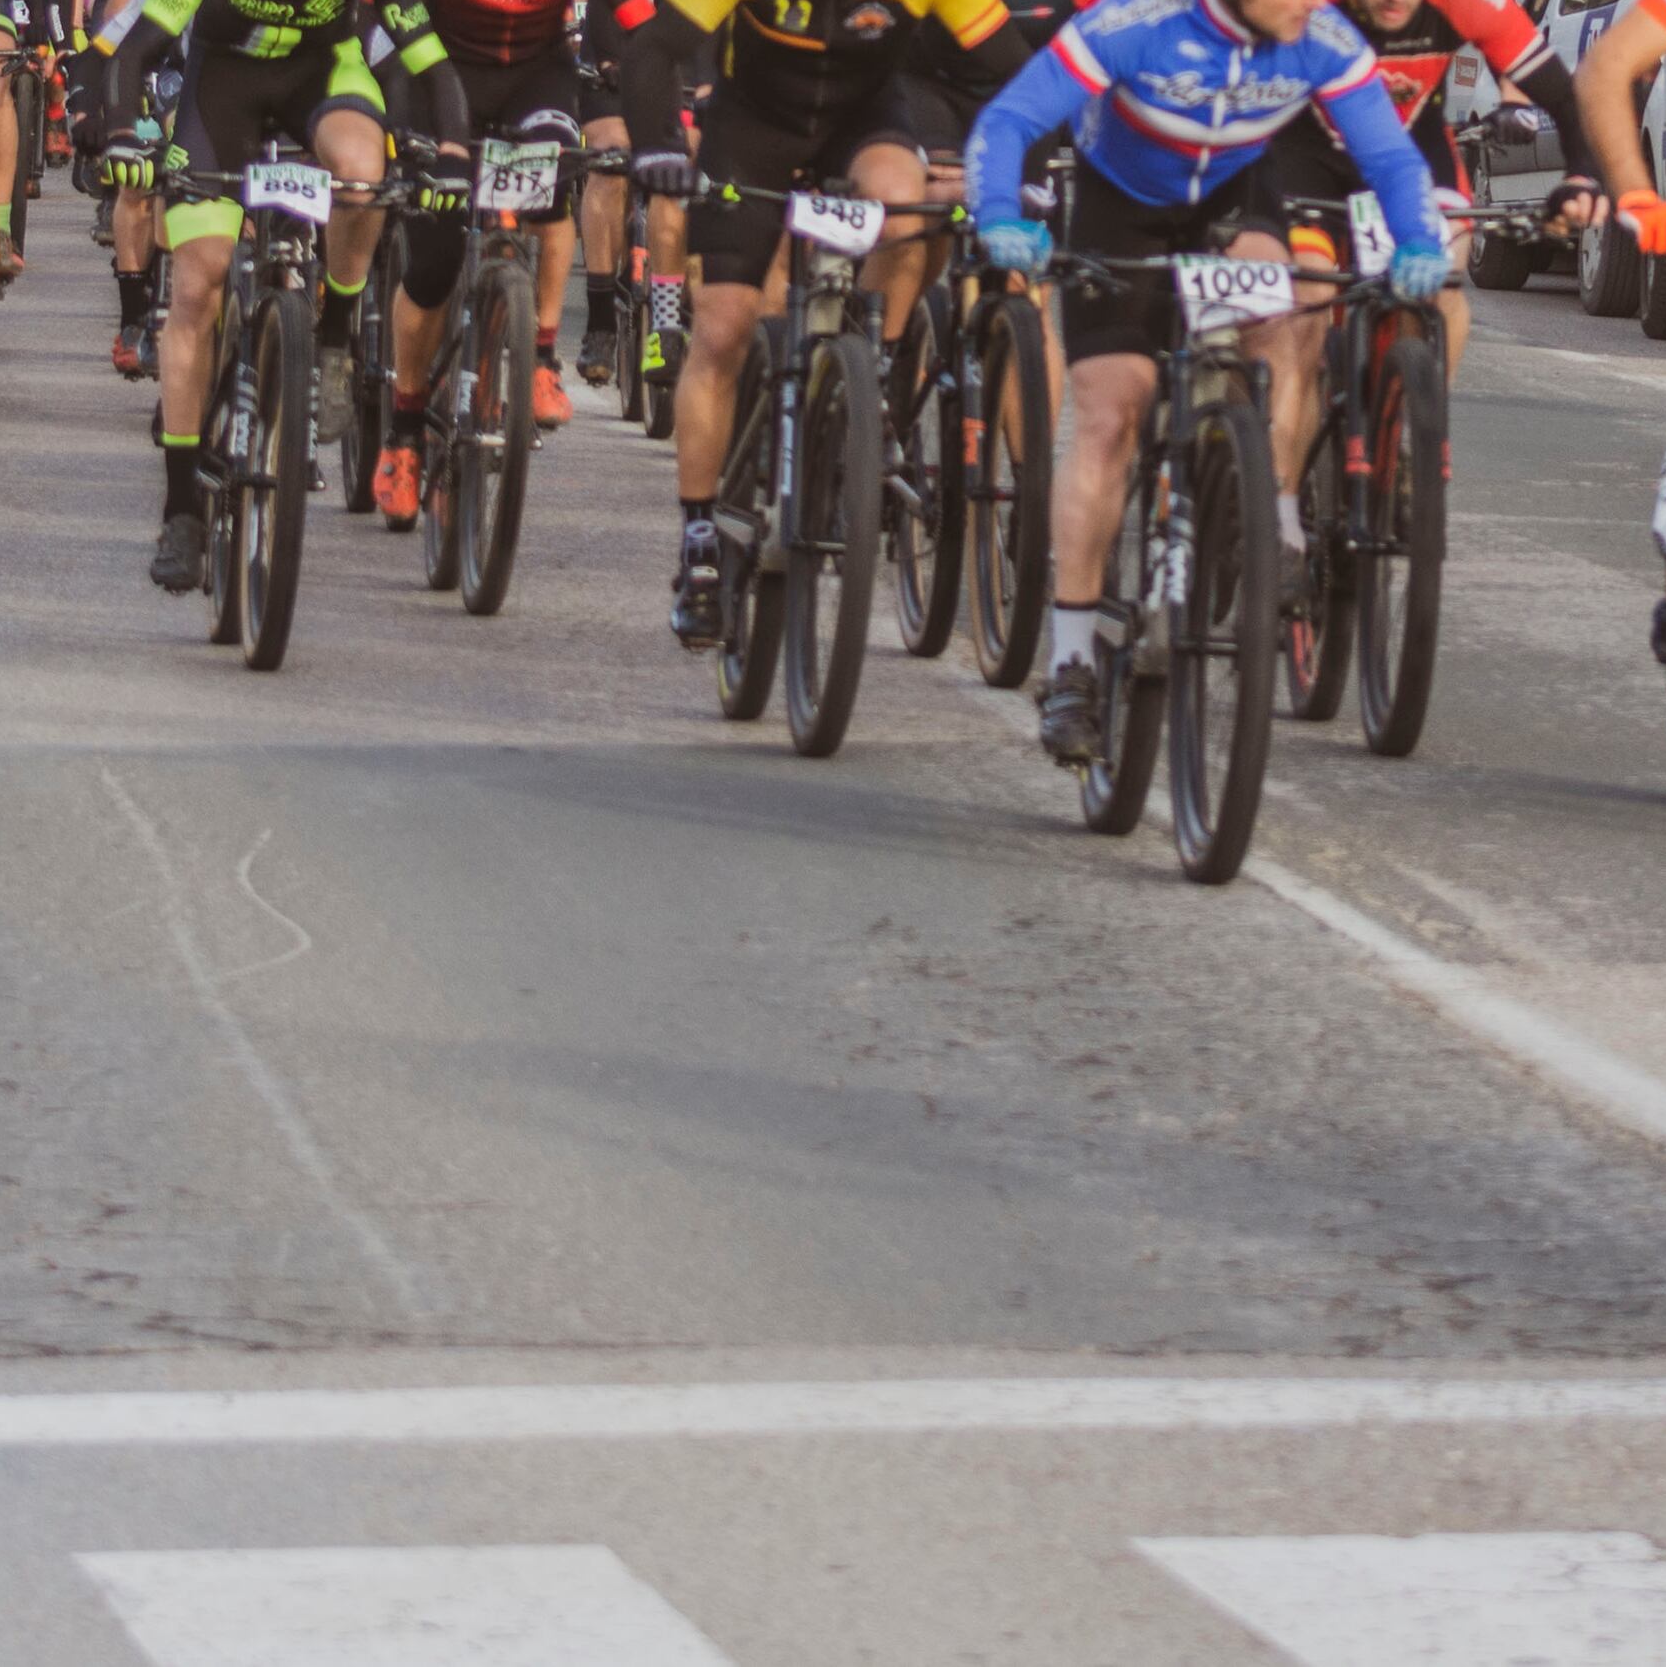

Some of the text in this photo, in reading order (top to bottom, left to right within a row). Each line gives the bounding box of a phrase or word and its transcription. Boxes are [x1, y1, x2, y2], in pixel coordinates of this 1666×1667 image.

[264, 180, 317, 199] 895
[494, 169, 544, 193] 817
[811, 196, 866, 230] 948
[1191, 264, 1280, 301] 1000
